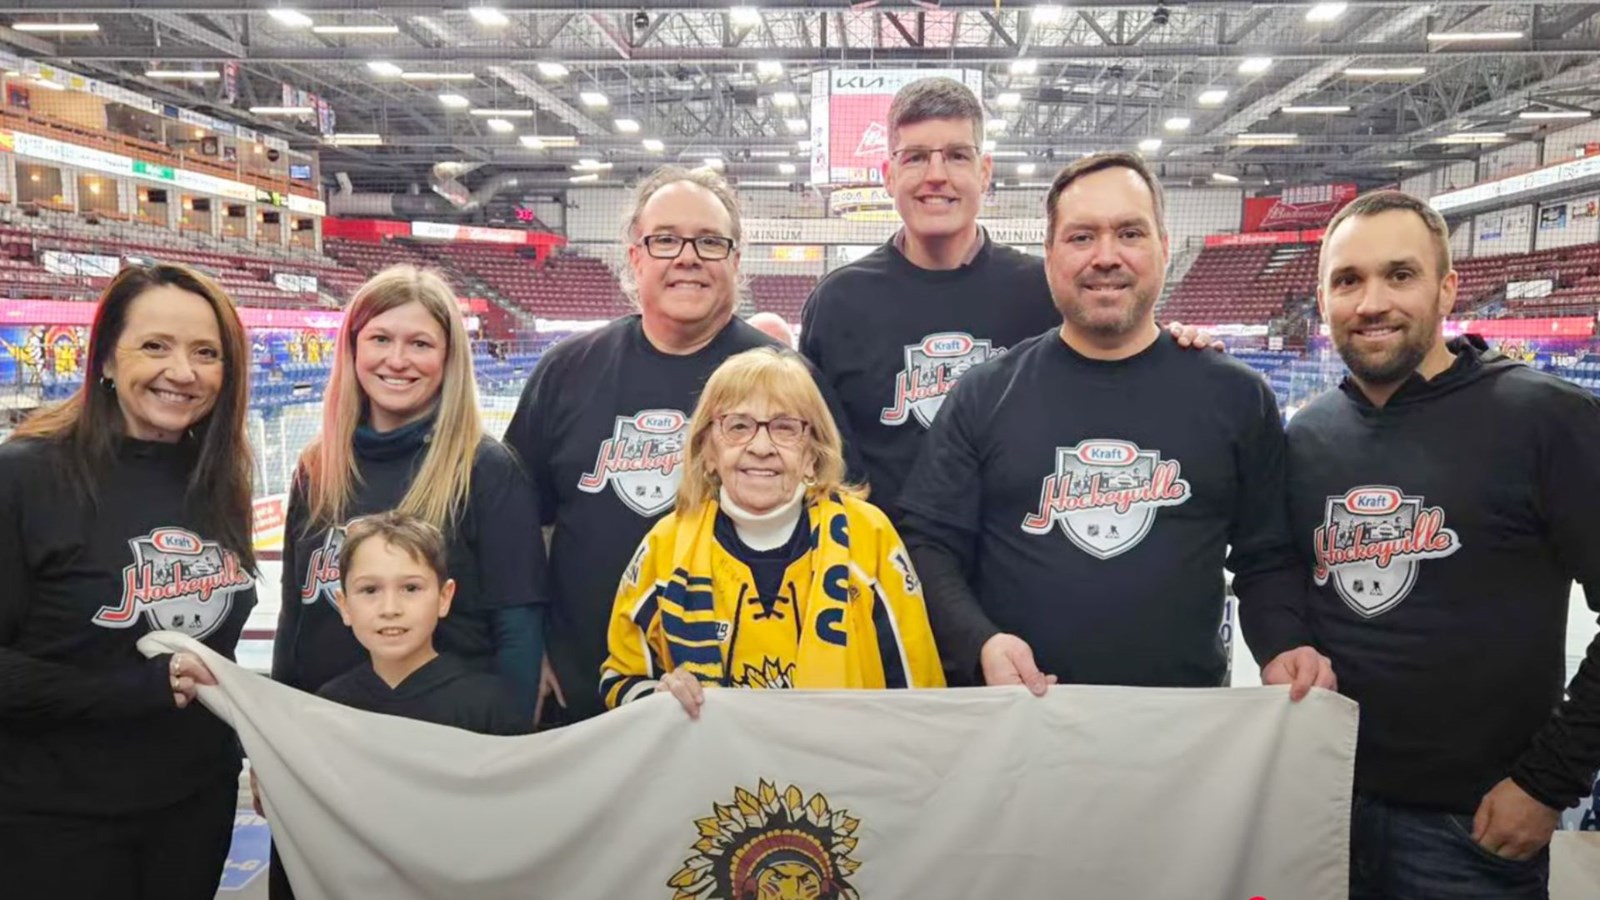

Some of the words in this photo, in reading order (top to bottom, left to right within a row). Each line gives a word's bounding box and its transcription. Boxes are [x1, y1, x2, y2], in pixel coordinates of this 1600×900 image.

[837, 76, 884, 88] KIA
[934, 341, 961, 351] Kraft
[645, 417, 672, 428] Kraft
[1091, 449, 1122, 460] Kraft
[1024, 461, 1185, 529] Hockeyville
[1357, 495, 1387, 508] Kraft
[165, 535, 193, 549] Kraft
[1314, 510, 1451, 580] Hockeyville
